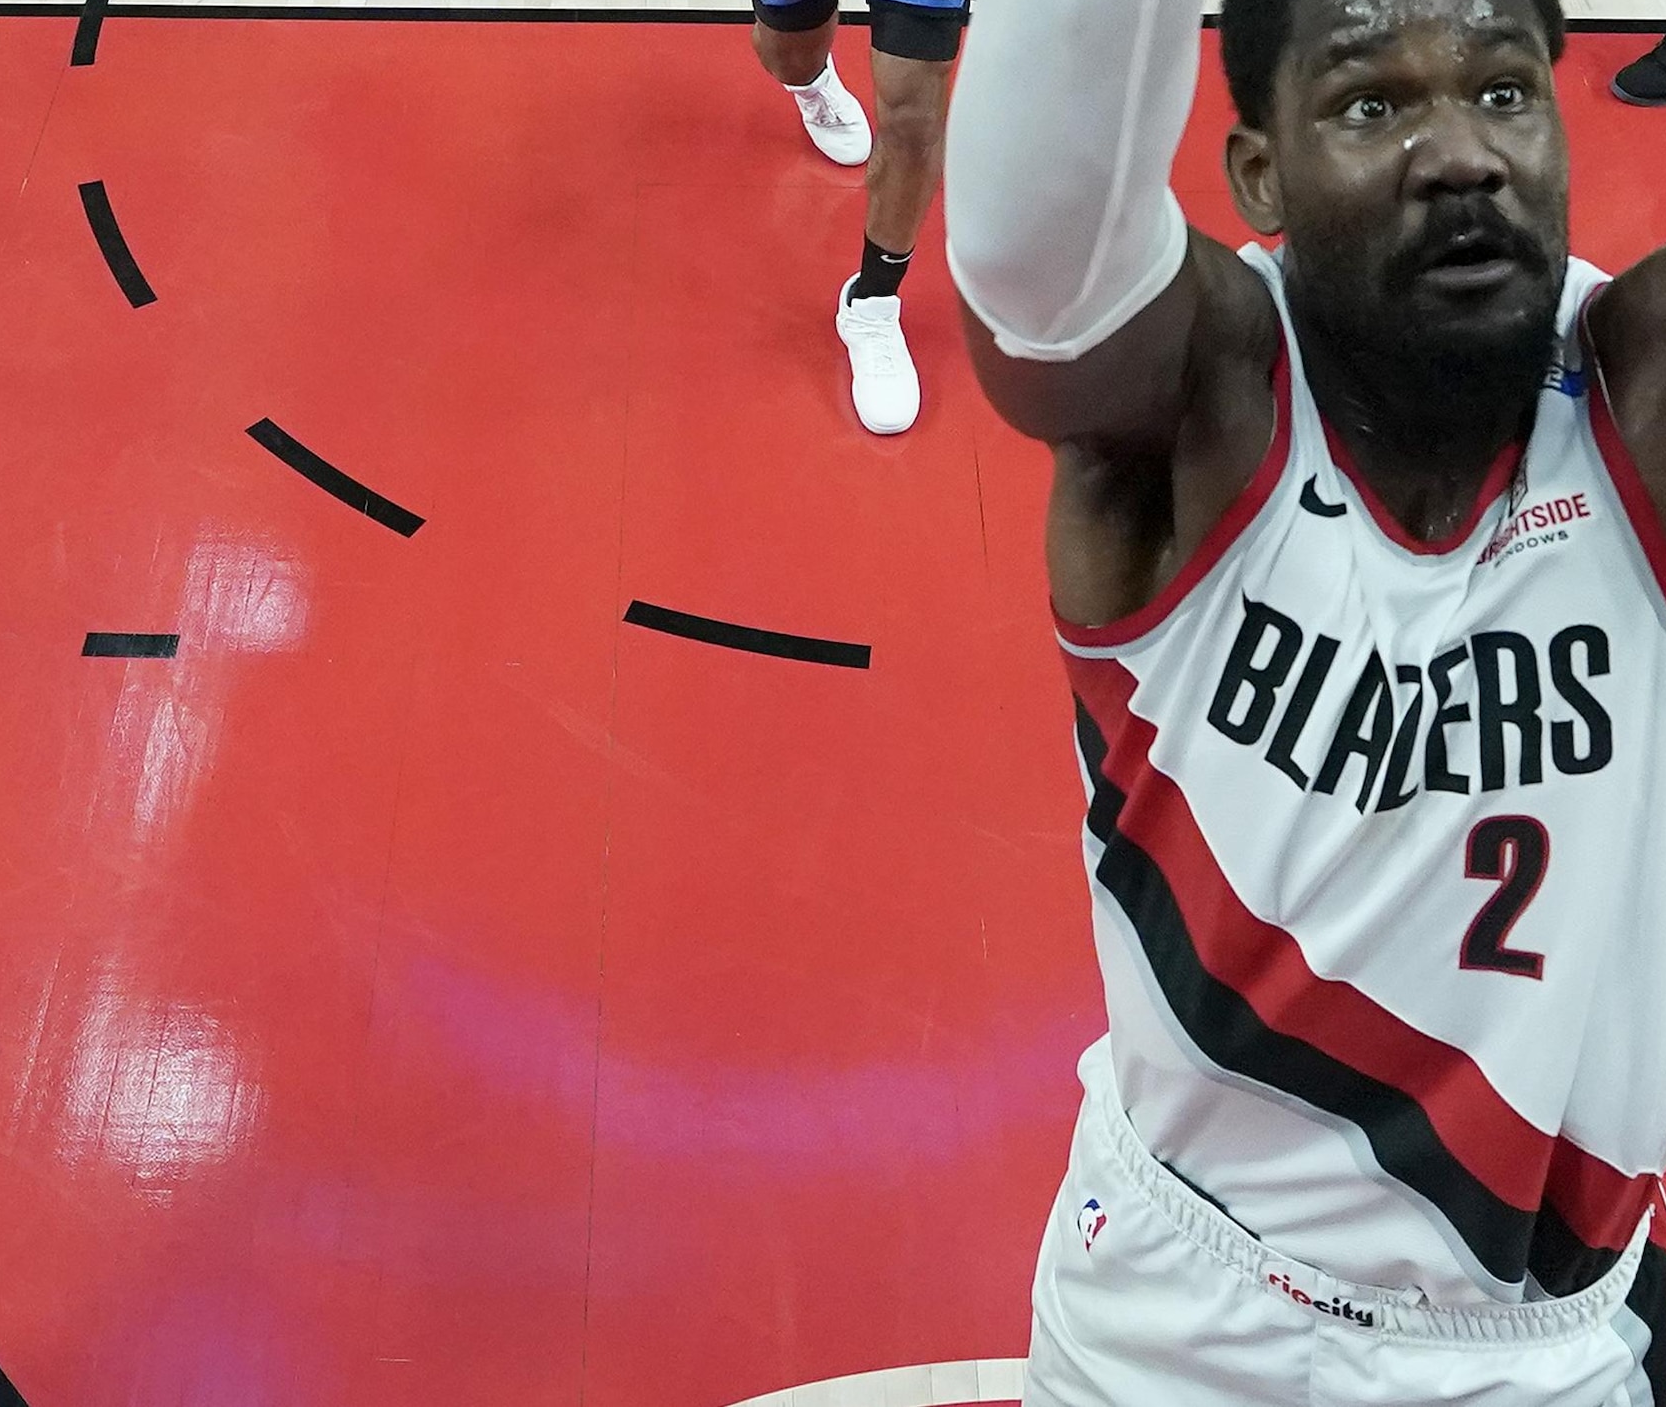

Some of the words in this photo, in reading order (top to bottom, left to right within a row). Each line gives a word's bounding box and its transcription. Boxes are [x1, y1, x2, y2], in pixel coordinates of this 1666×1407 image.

[1206, 587, 1615, 816] BLAZERS
[1459, 814, 1551, 982] 2
[1268, 1273, 1373, 1327] ripcity
